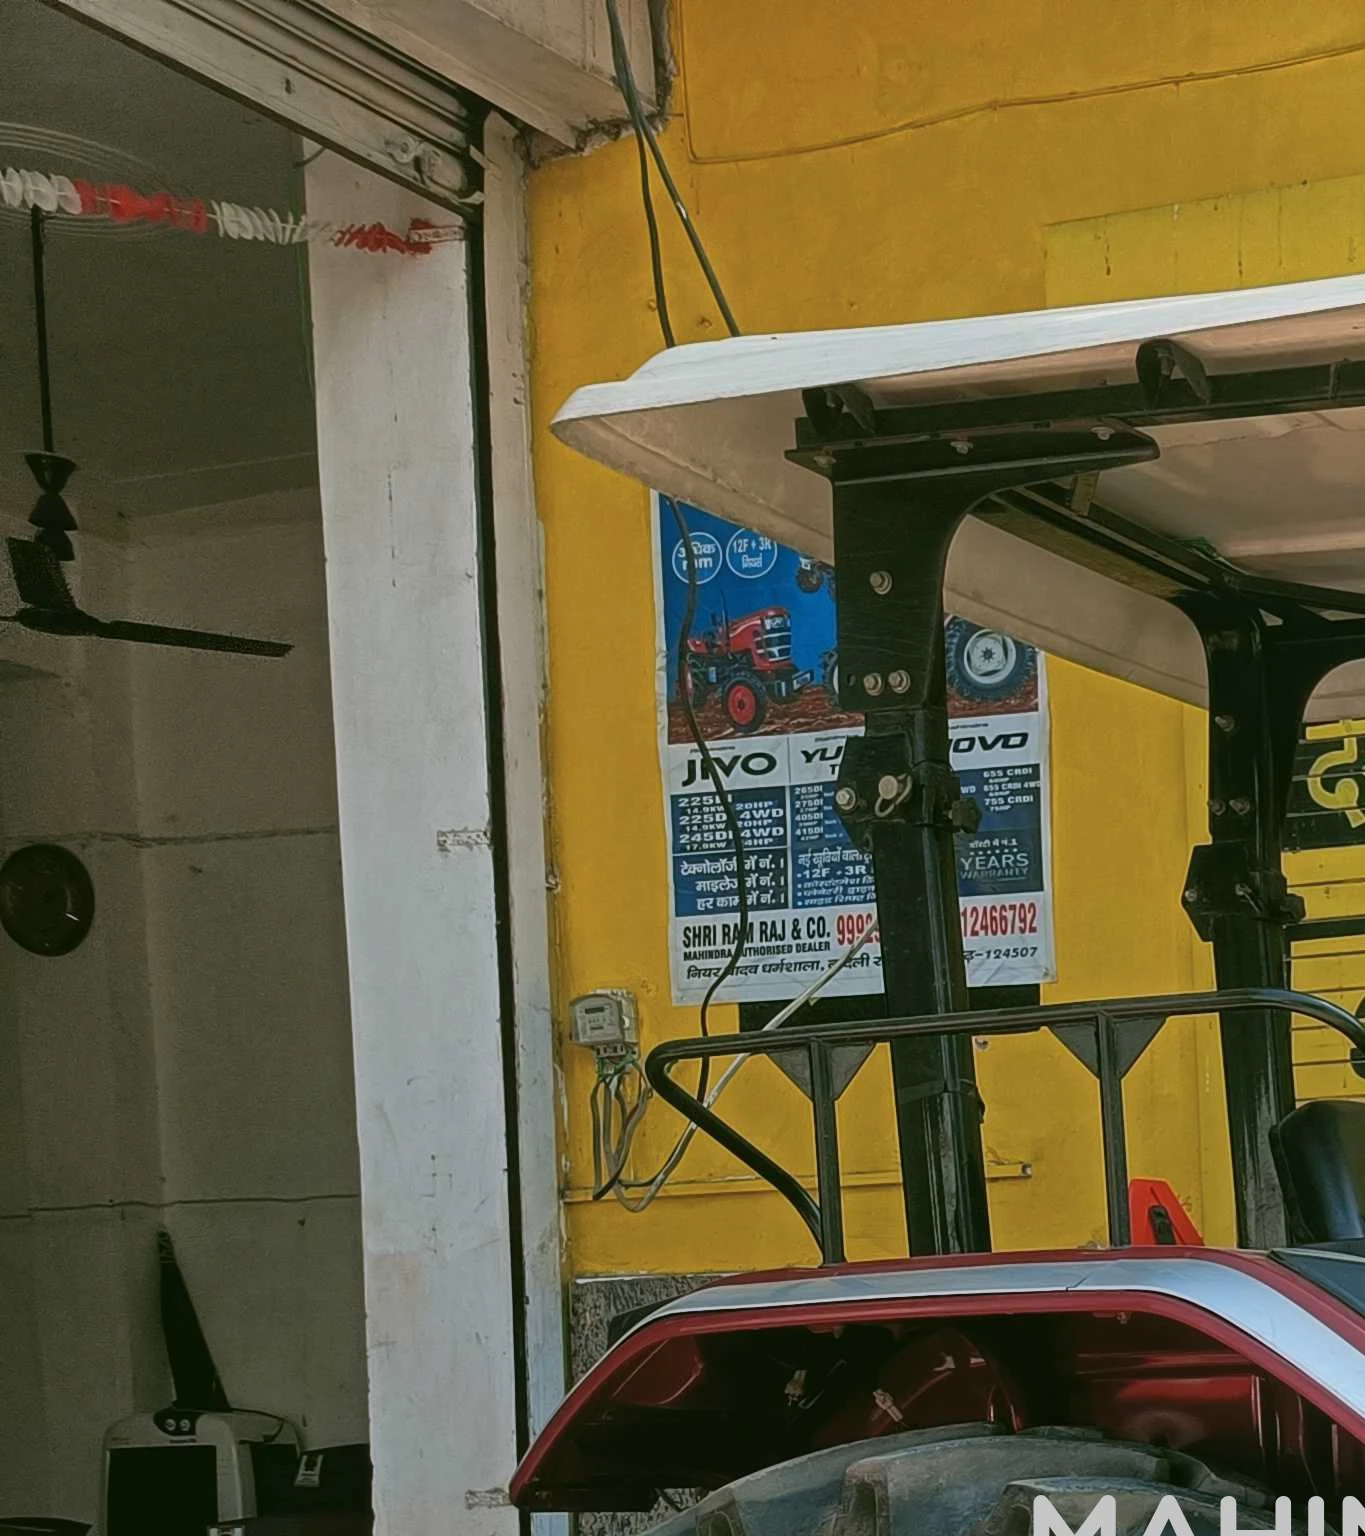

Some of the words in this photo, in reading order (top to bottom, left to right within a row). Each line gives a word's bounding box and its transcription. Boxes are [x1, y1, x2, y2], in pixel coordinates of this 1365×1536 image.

[949, 732, 1029, 754] OVO
[800, 745, 844, 764] YU
[679, 813, 728, 826] 225D
[744, 838, 774, 847] 4HP
[960, 852, 1029, 871] YEARS
[683, 923, 717, 949] SHRI
[759, 916, 786, 943] RAJ
[791, 917, 801, 940] &
[806, 915, 831, 939] CO.
[683, 948, 733, 961] MAHINDRA
[738, 944, 793, 958] UTHORISED
[795, 941, 831, 955] DEALER
